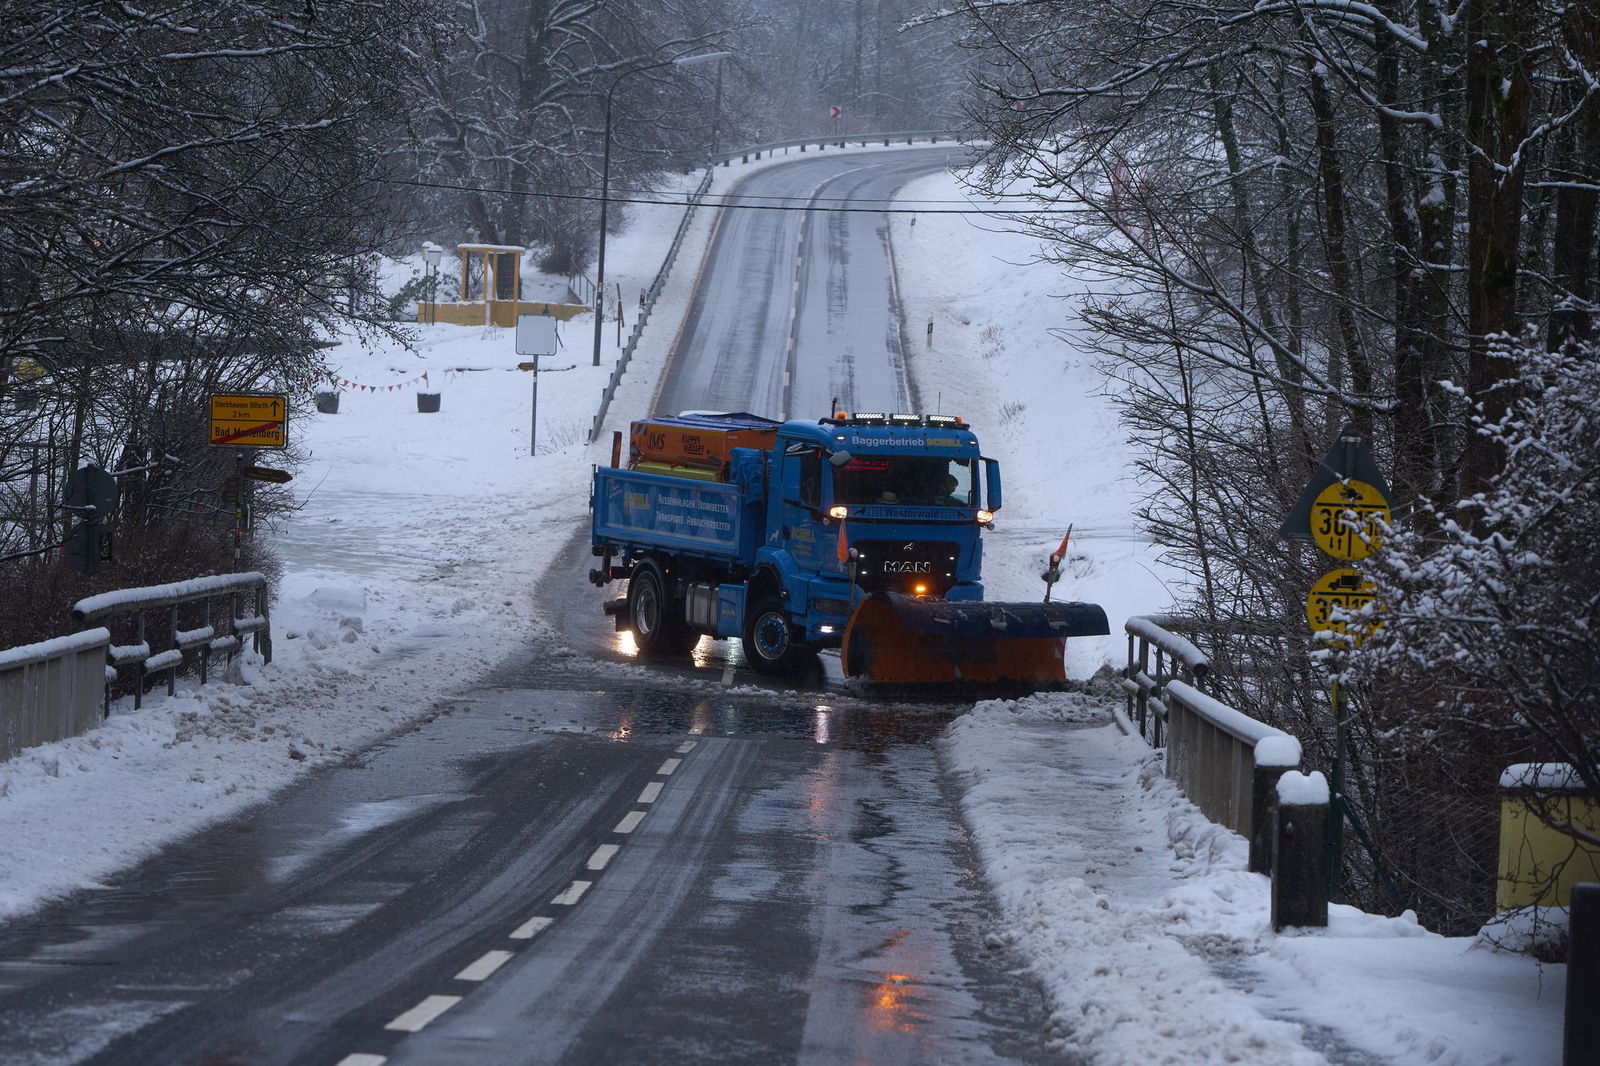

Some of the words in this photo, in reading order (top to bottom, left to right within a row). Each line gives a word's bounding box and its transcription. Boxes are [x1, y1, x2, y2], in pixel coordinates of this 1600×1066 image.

[215, 426, 230, 437] Bad
[851, 436, 925, 447] Baggerbetrieb
[885, 508, 938, 518] Westerwald
[1319, 508, 1347, 537] 30
[884, 560, 931, 573] MAN
